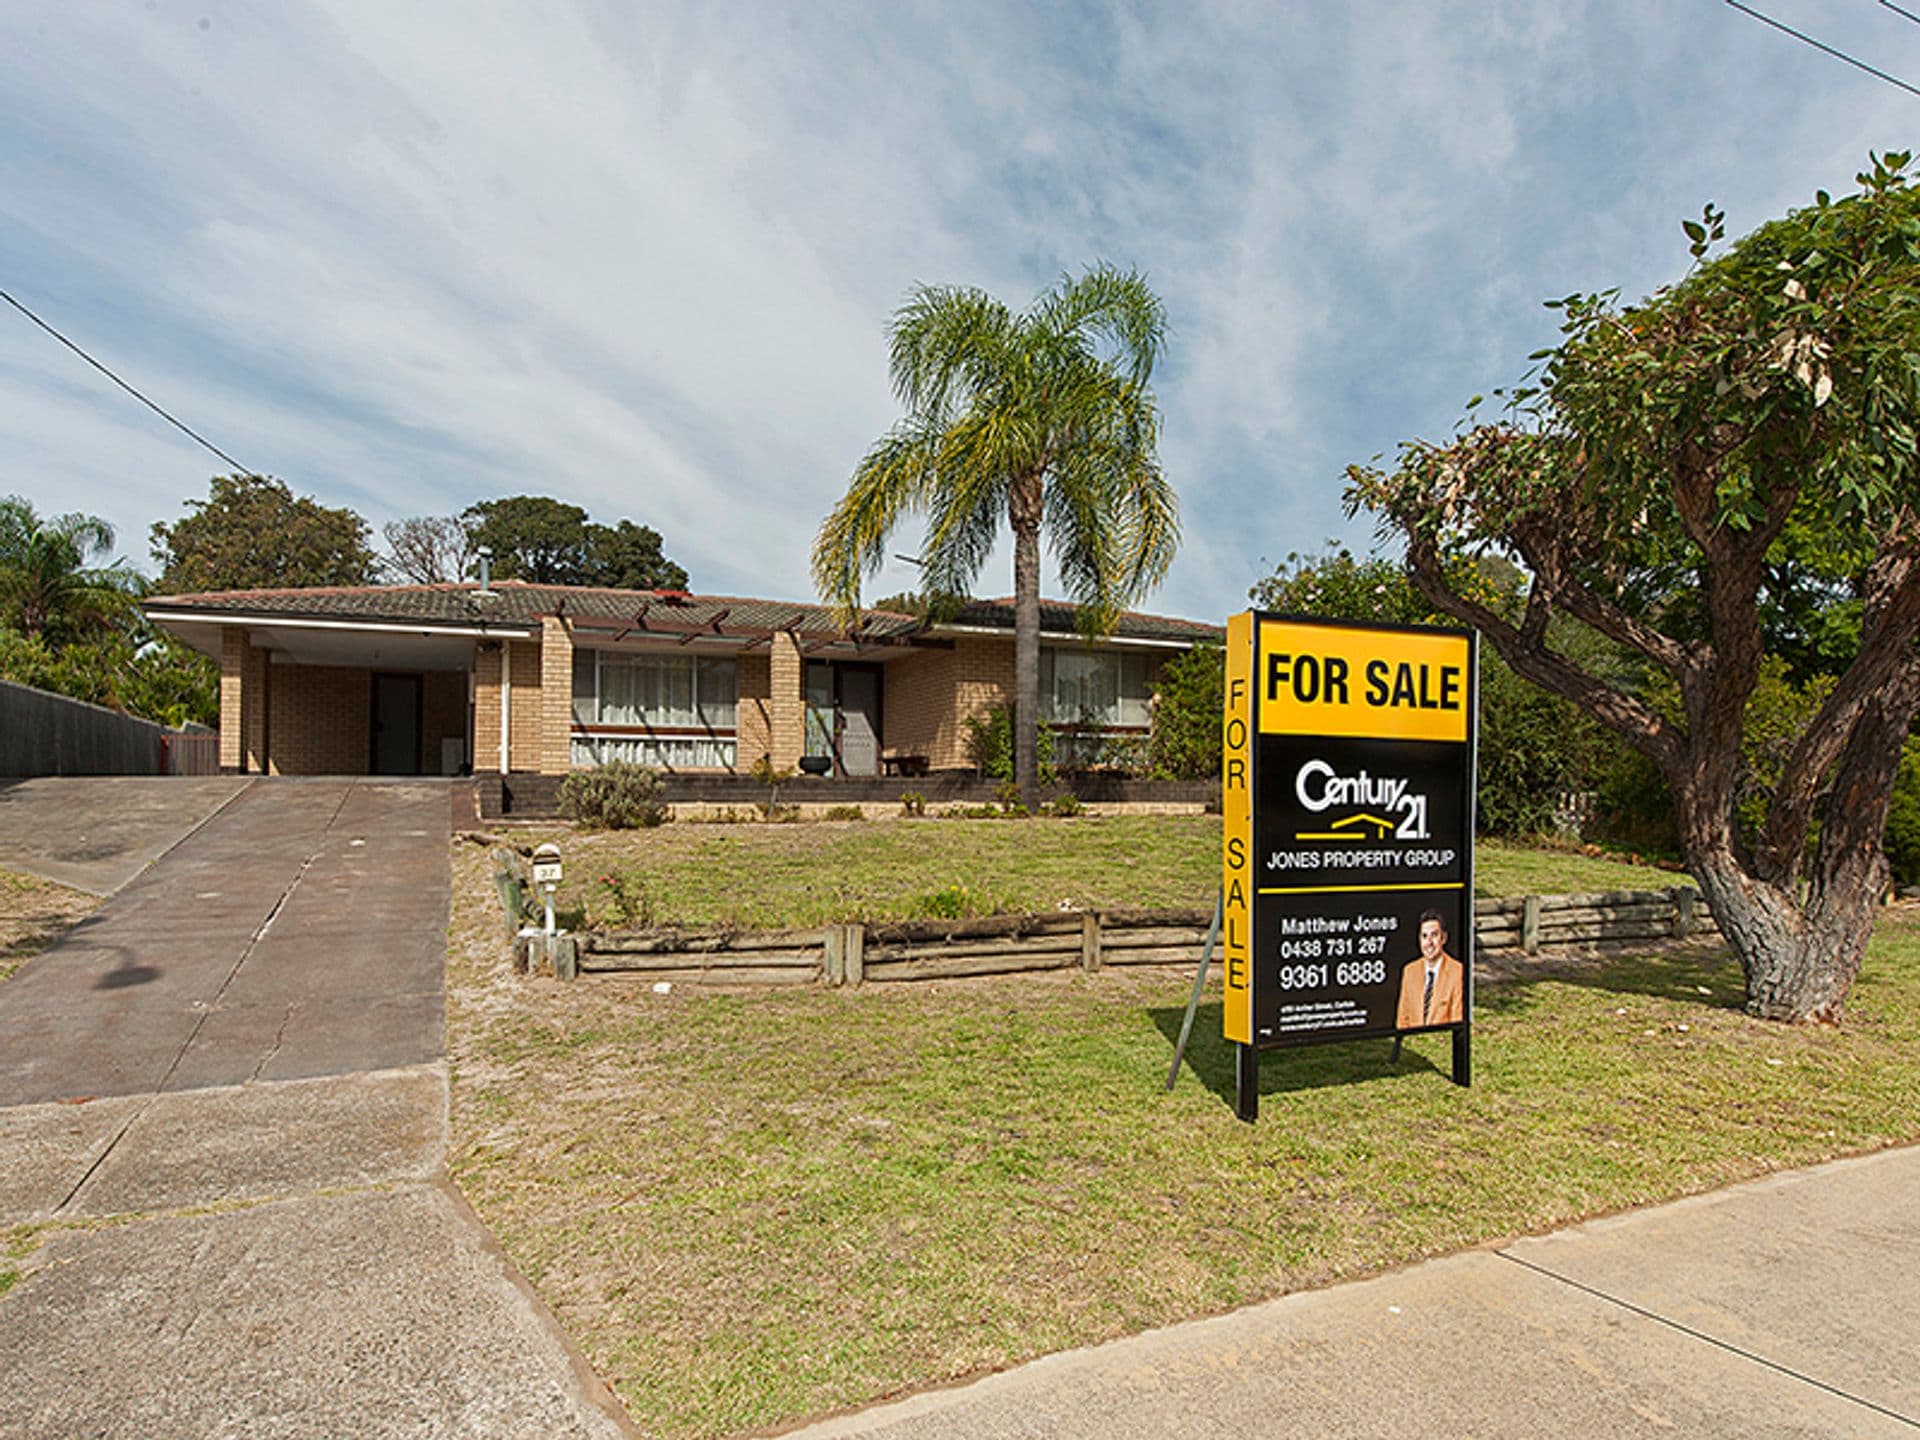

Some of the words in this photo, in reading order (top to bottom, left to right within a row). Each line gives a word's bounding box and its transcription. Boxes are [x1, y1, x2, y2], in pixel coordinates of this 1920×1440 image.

[1267, 652, 1349, 705] FOR
[1365, 659, 1461, 711] SALE
[1226, 678, 1247, 790] FOR
[1295, 758, 1409, 813] Century
[1395, 794, 1428, 840] 21
[1266, 851, 1320, 870] JONES
[1323, 850, 1402, 869] PROPERTY
[1404, 849, 1456, 867] GROUP
[1226, 837, 1247, 990] SALE
[1281, 916, 1350, 935] Matthew
[1353, 914, 1399, 932] Jones
[1281, 939, 1322, 959] 0438
[1326, 938, 1353, 956] 731
[1358, 935, 1387, 954] 267
[1280, 964, 1328, 990] 9361
[1336, 960, 1386, 986] 6888
